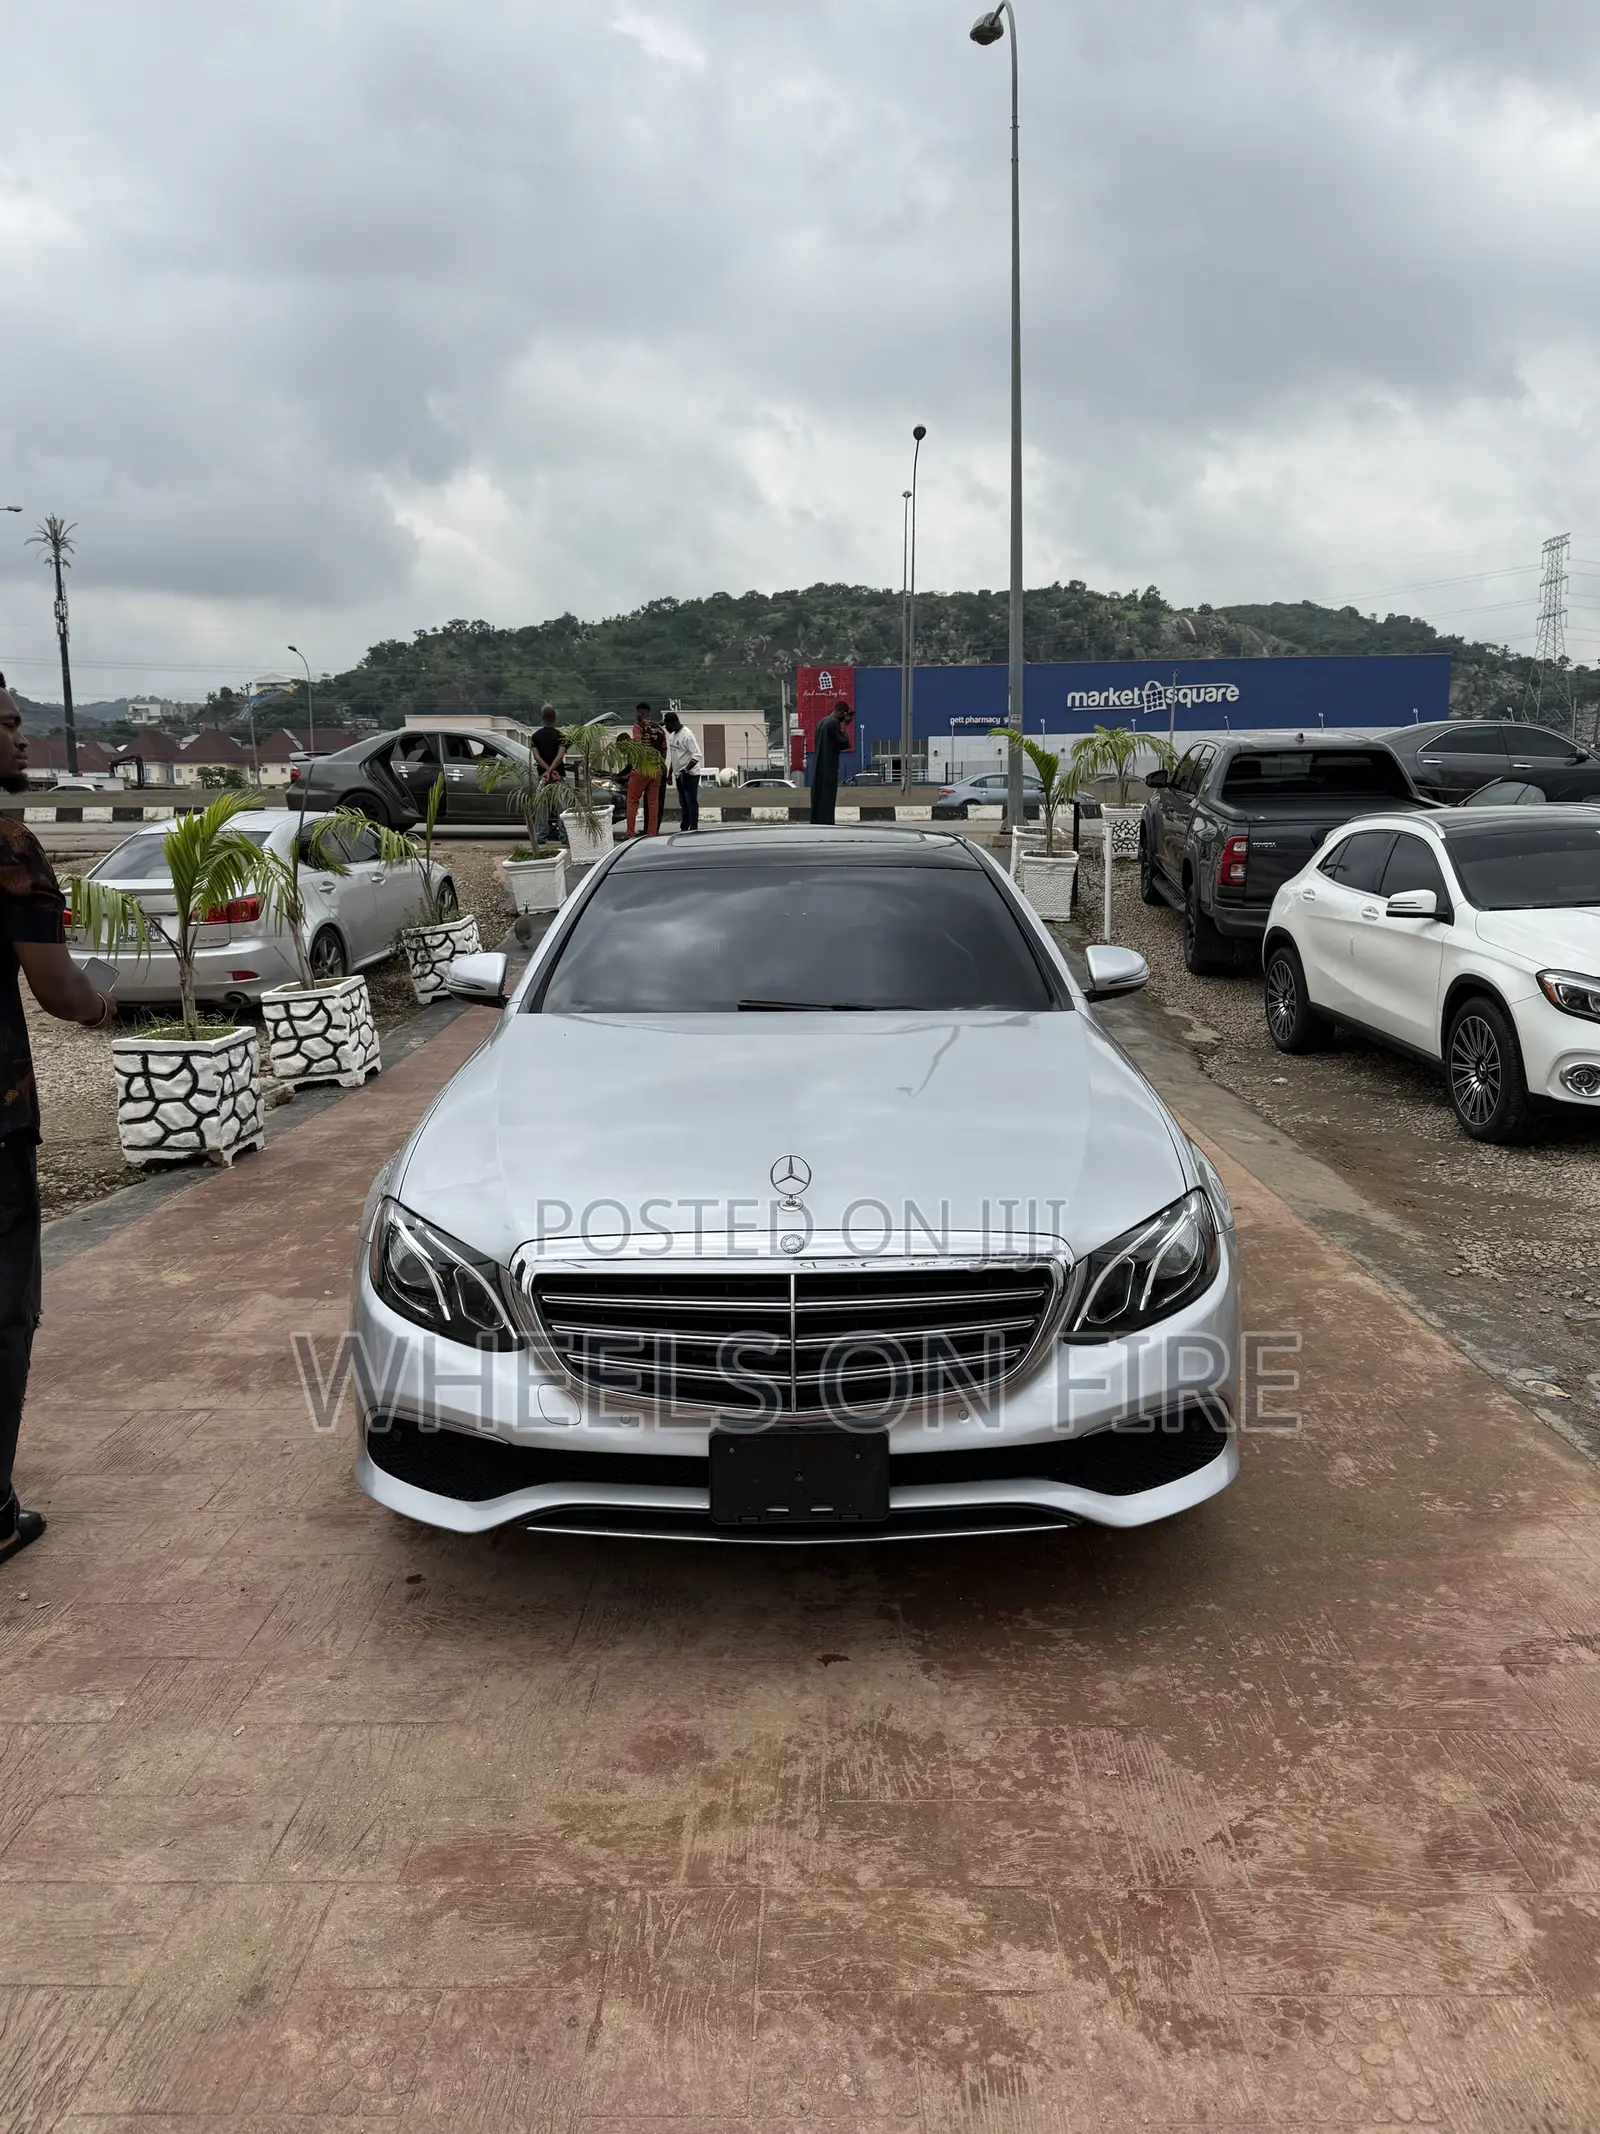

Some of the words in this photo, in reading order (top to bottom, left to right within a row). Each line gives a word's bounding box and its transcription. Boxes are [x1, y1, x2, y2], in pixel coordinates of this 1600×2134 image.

[1066, 687, 1141, 707] market
[1165, 686, 1240, 708] square
[965, 716, 1001, 725] pharmacy
